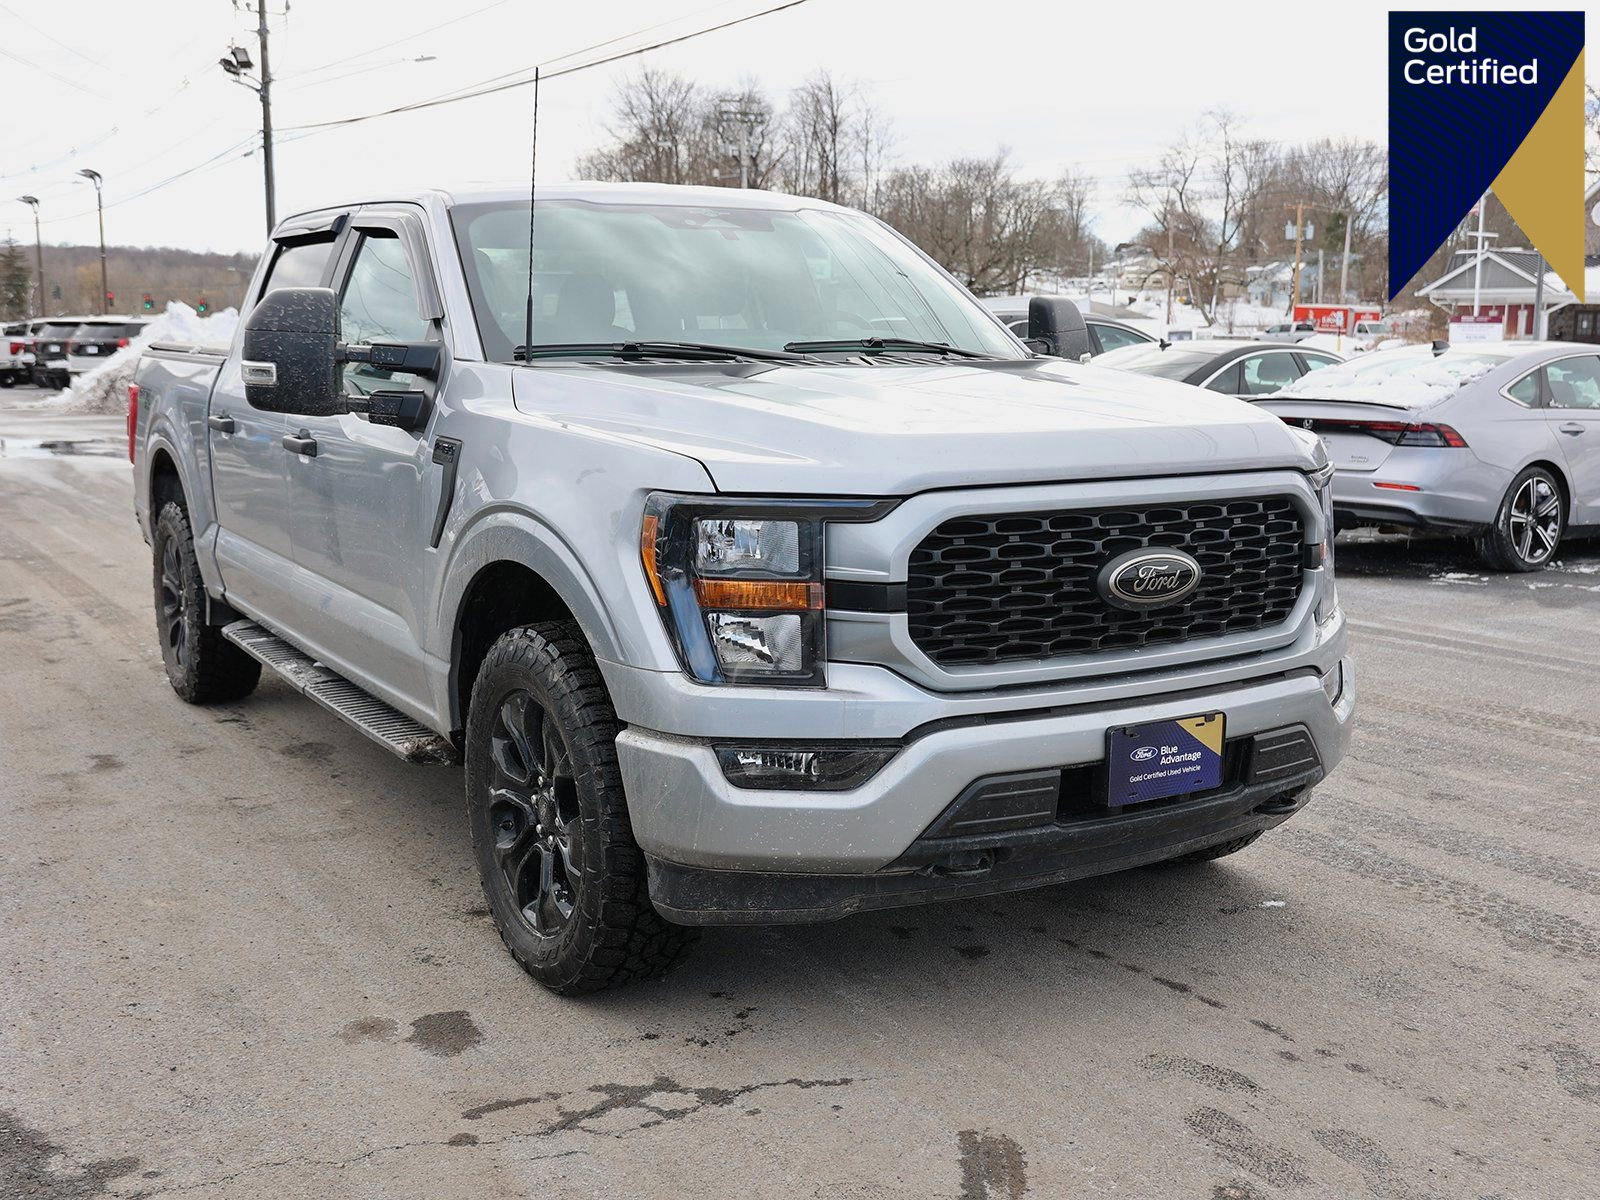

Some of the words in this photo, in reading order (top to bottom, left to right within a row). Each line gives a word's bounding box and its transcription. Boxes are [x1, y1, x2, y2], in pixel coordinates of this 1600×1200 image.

[1133, 565, 1181, 593] Ford
[1135, 748, 1153, 759] Ford
[1160, 745, 1178, 755] Blue
[1160, 751, 1202, 765] Advantage
[1129, 774, 1143, 783] Gold
[1143, 771, 1167, 780] Certified
[1167, 768, 1182, 776] Used
[1182, 765, 1201, 773] Vehicle
